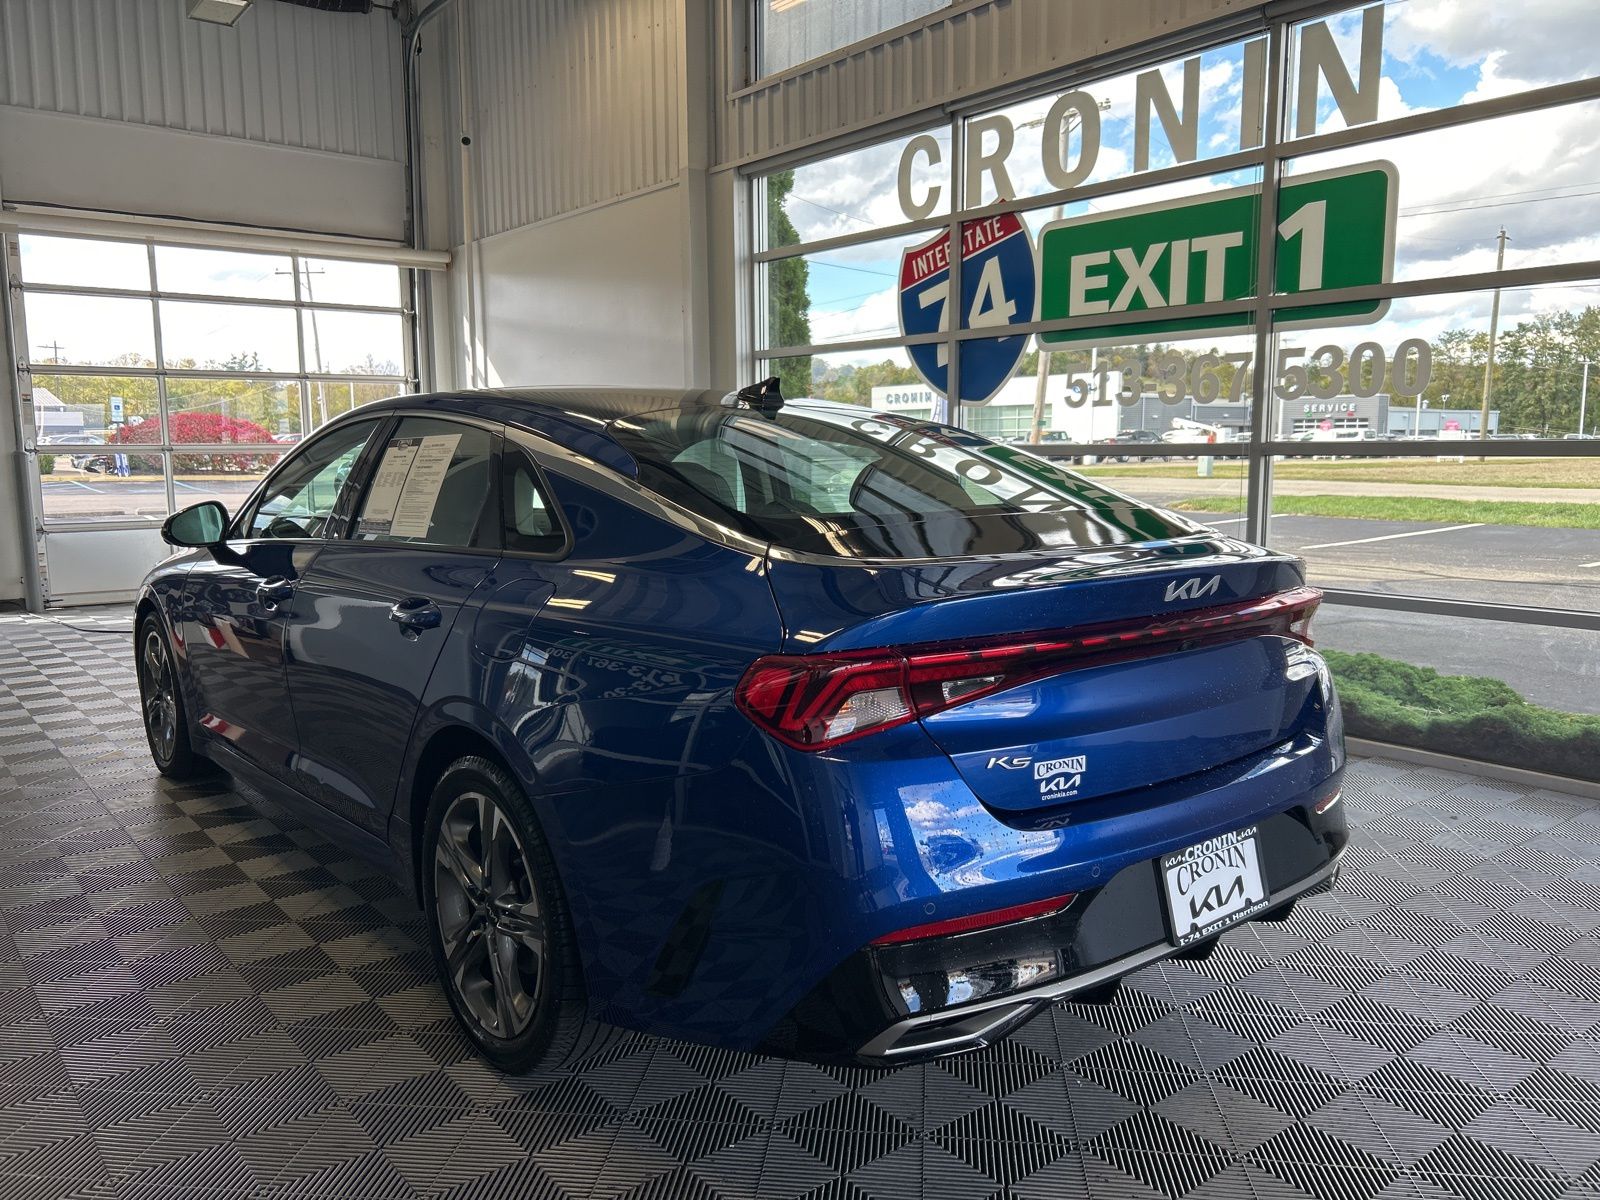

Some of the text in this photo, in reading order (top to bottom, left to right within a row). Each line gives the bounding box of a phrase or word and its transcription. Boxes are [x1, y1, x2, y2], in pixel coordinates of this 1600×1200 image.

[897, 5, 1384, 221] CRONIN
[1069, 200, 1327, 317] EXIT 1
[918, 255, 1016, 367] 74
[886, 391, 932, 405] CRONIN
[1303, 402, 1356, 413] SERVICE
[985, 756, 1032, 769] K5
[1037, 757, 1084, 778] CRONIN
[1041, 789, 1078, 801] croninkia.com
[1185, 831, 1237, 862] CRONIN
[1177, 842, 1247, 896] CRONIN
[1180, 900, 1269, 946] I-74 EXIT 1 Harrison
